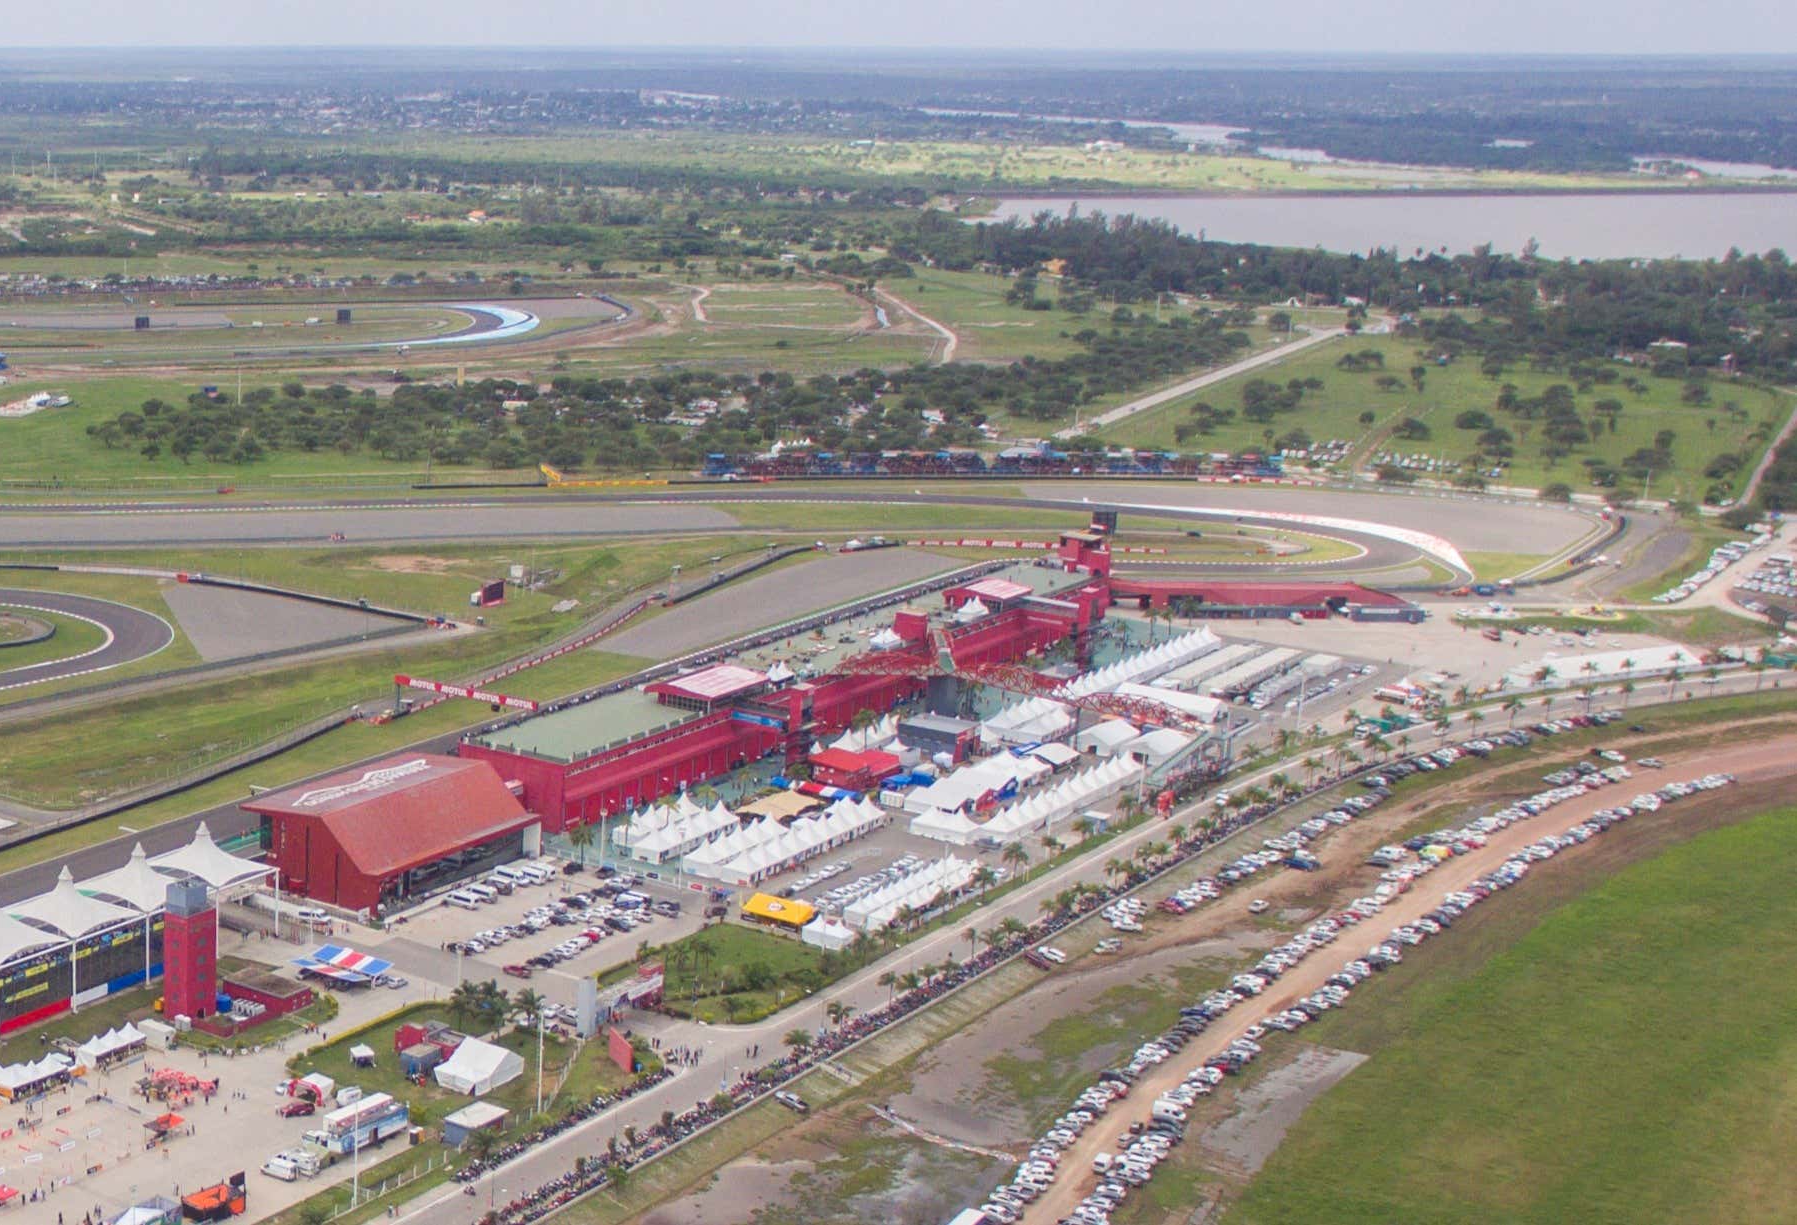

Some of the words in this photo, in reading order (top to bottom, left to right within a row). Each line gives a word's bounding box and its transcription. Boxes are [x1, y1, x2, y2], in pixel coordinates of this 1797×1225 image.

[409, 679, 435, 690] MOTUL
[441, 684, 467, 697] MOTUL
[473, 692, 500, 704] MOTUL
[505, 698, 533, 709] MOTUL
